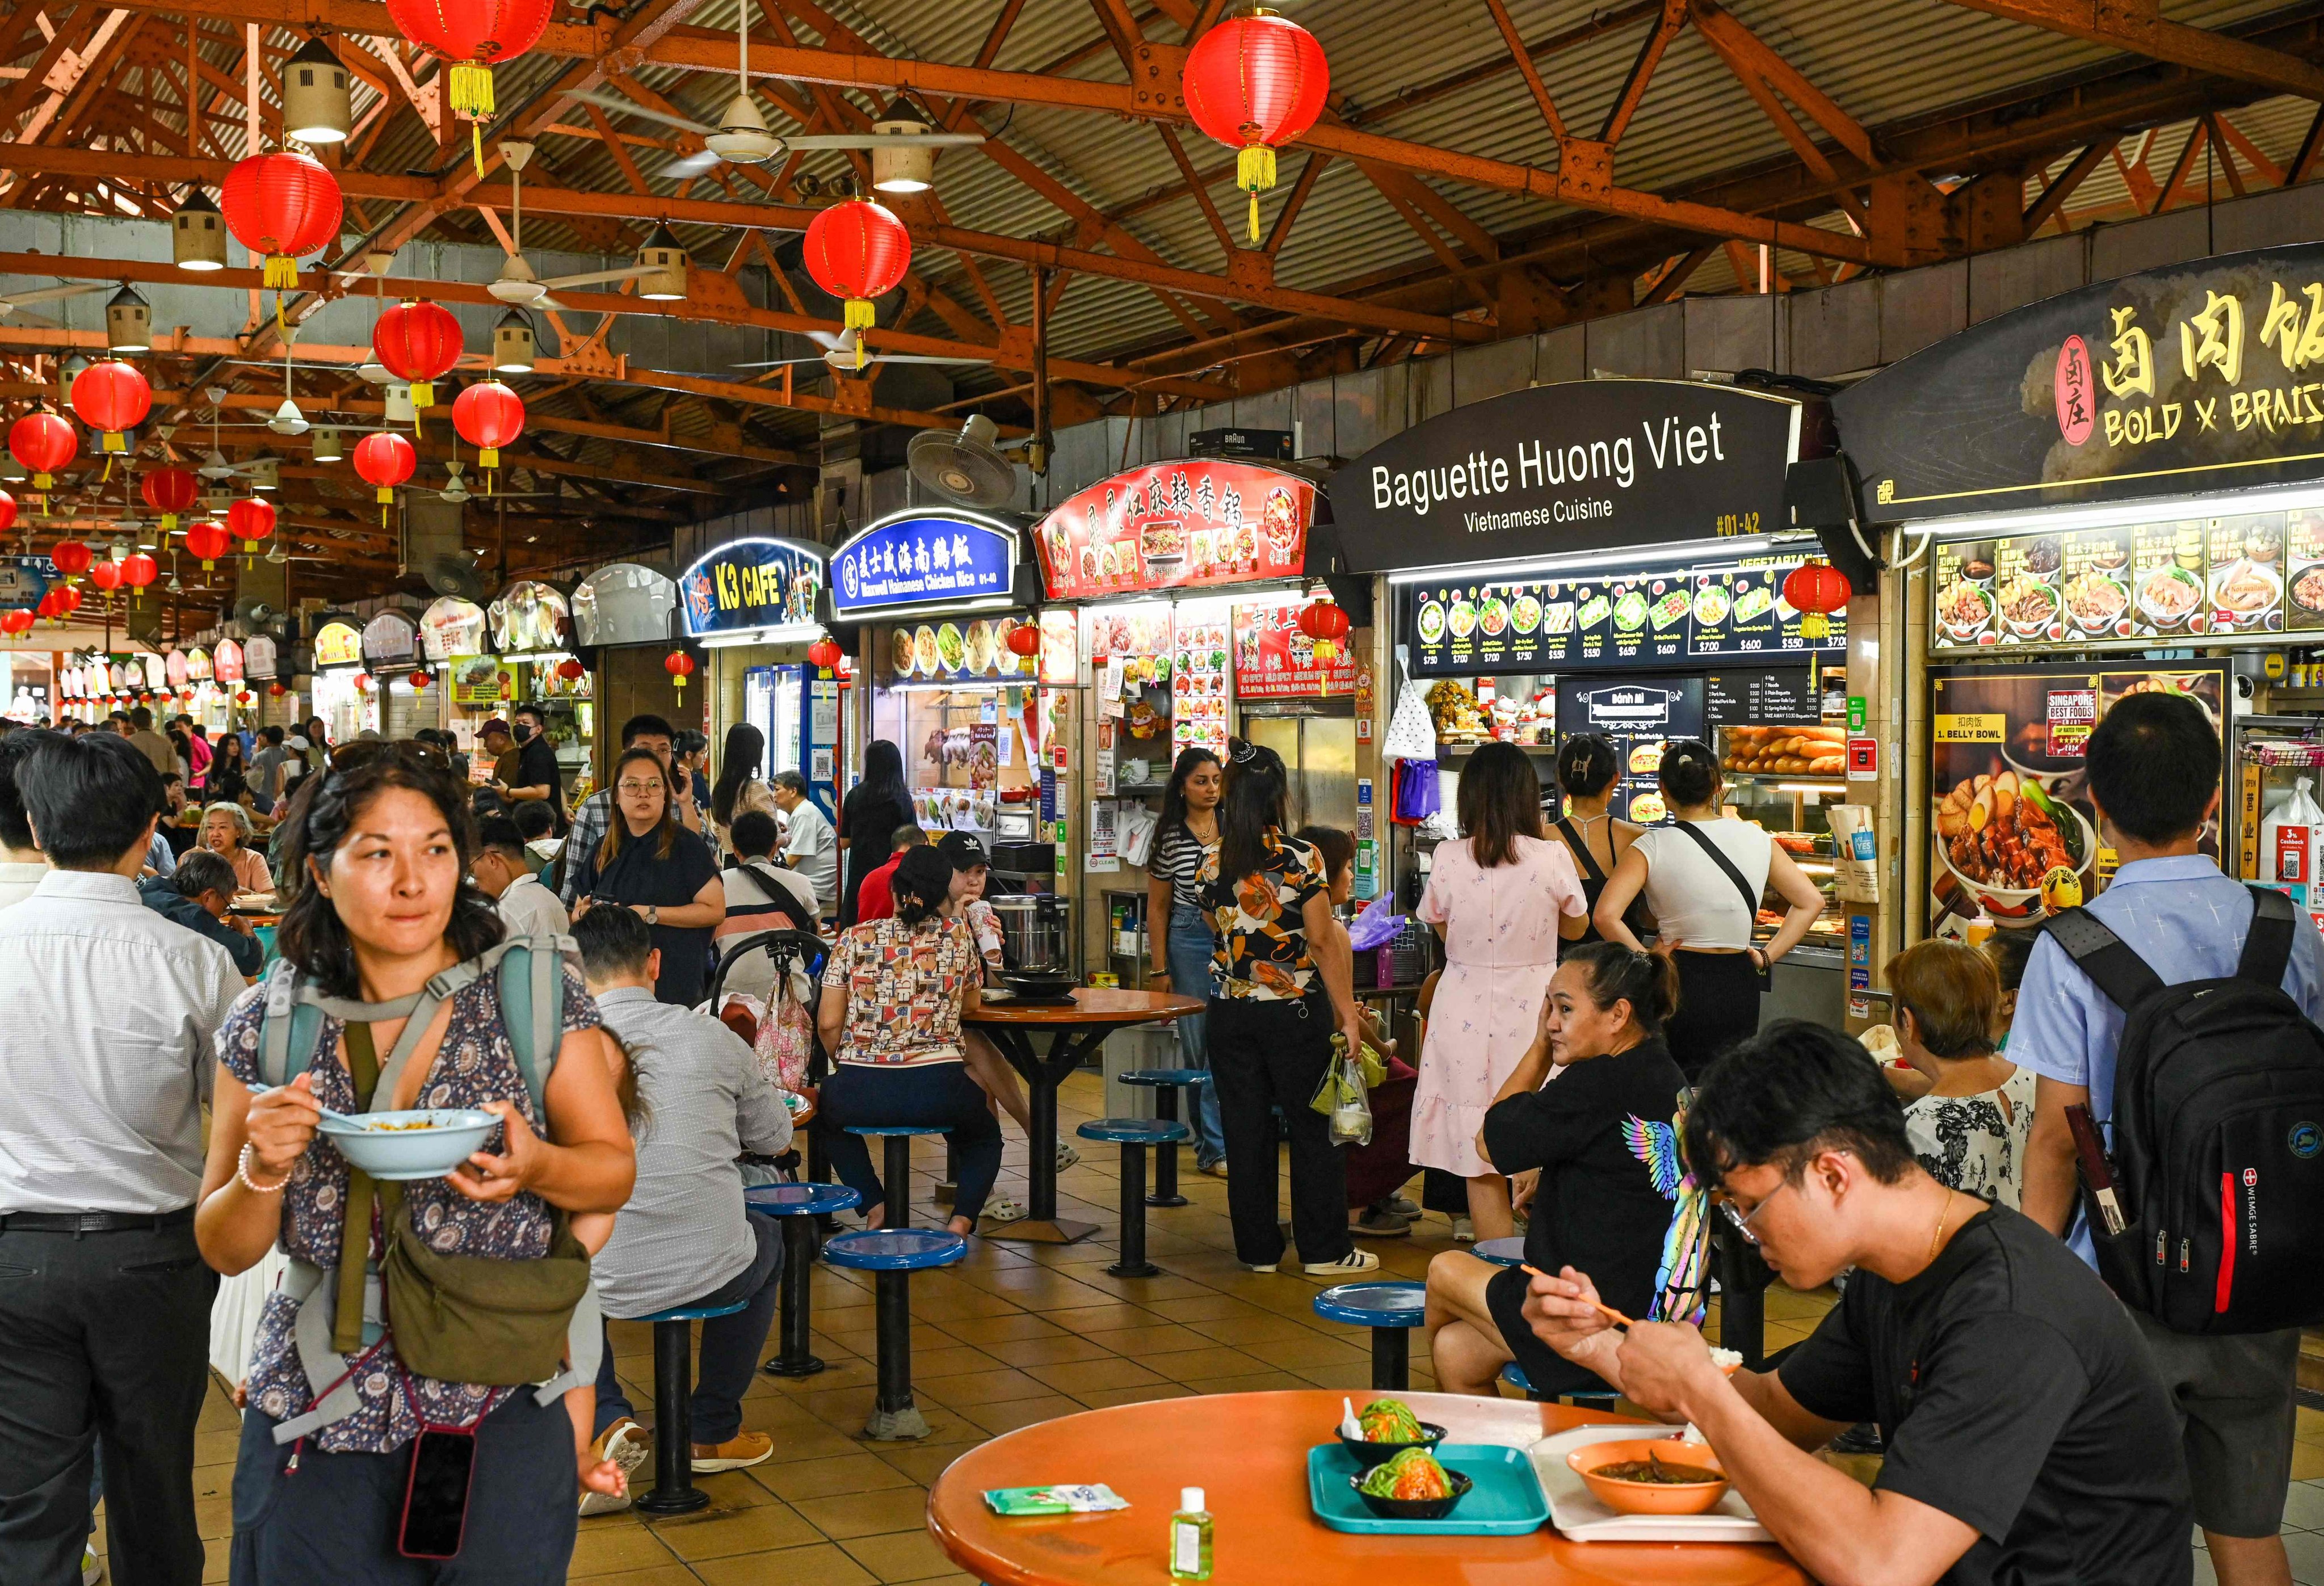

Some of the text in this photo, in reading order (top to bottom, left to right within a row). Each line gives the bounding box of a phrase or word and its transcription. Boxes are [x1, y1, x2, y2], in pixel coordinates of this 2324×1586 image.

[2102, 281, 2324, 398] 卤肉饭
[2104, 402, 2182, 448] BOLD
[2230, 383, 2324, 435] BRAIS
[1225, 433, 1245, 444] BRAUN
[1372, 411, 1725, 516] Baguette Huong Viet
[1464, 499, 1613, 533] Vietnamese Cuisine
[1716, 512, 1760, 536] #01-42
[861, 570, 997, 597] Maxwell Hainanese Chicken Rice 01-40
[1725, 574, 1730, 583] 9
[1766, 572, 1773, 580] 10
[715, 563, 740, 611] K3
[742, 561, 780, 608] CAFE
[1699, 641, 1719, 651] $7.00
[1265, 653, 1283, 671] 小辣
[1241, 669, 1351, 683] NO SPICY MILD SPICY MEDIUM SUPER
[2049, 694, 2094, 706] SINGAPORE
[2050, 707, 2092, 717] BEST FOODS
[1958, 716, 1982, 727] 扣肉饭
[2244, 793, 2254, 866] 营业中
[2287, 829, 2297, 839] 3%
[2247, 1187, 2256, 1222] WEMGE
